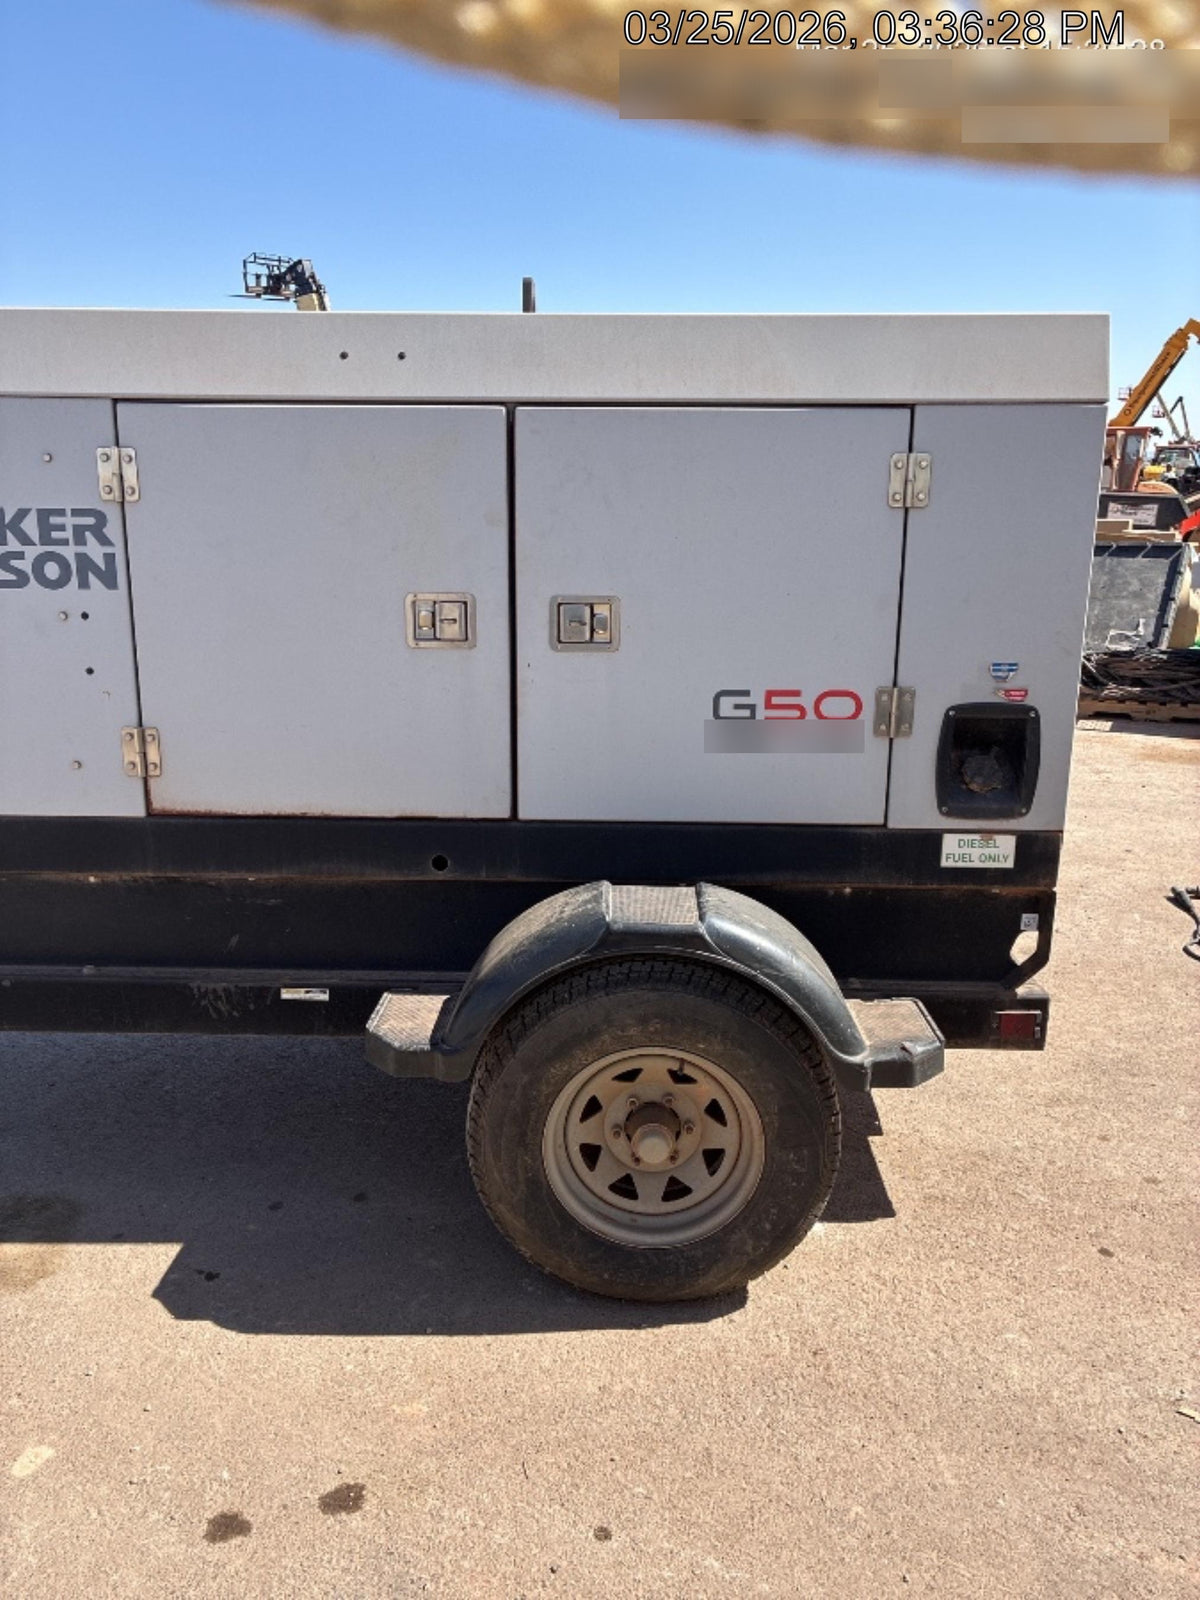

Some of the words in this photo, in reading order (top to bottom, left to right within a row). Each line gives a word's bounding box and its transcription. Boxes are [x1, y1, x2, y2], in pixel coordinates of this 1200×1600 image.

[712, 689, 864, 720] G50
[958, 838, 1000, 849] DIESEL
[945, 852, 975, 863] FUEL
[979, 852, 1010, 863] ONLY
